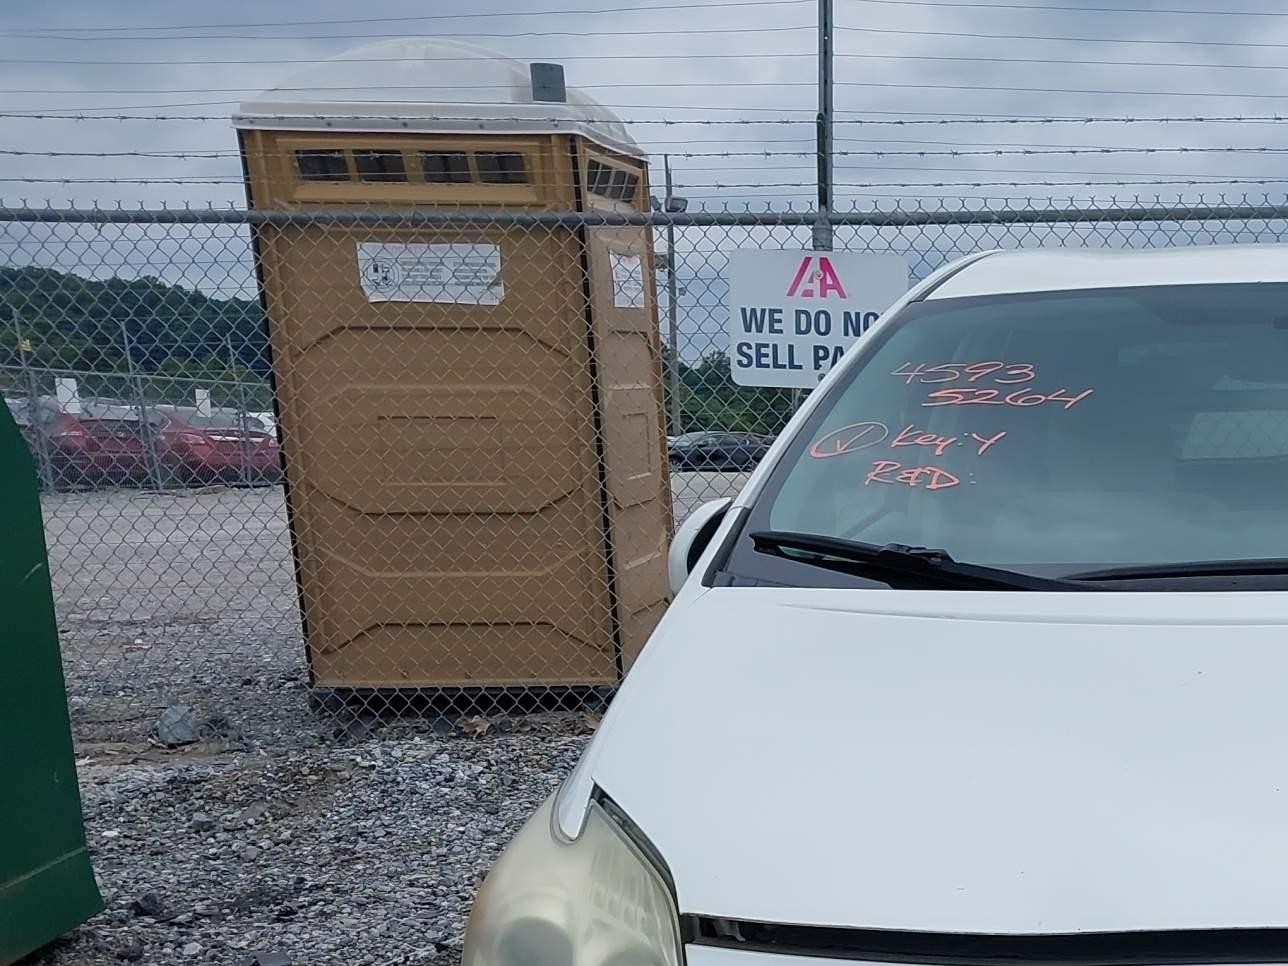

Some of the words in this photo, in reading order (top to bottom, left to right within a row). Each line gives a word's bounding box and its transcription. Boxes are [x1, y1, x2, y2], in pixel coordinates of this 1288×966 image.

[740, 307, 784, 335] WE
[794, 309, 832, 337] DO
[843, 311, 884, 337] NO
[736, 341, 803, 370] SELL
[890, 361, 1036, 384] 4593
[921, 388, 1094, 409] 5264
